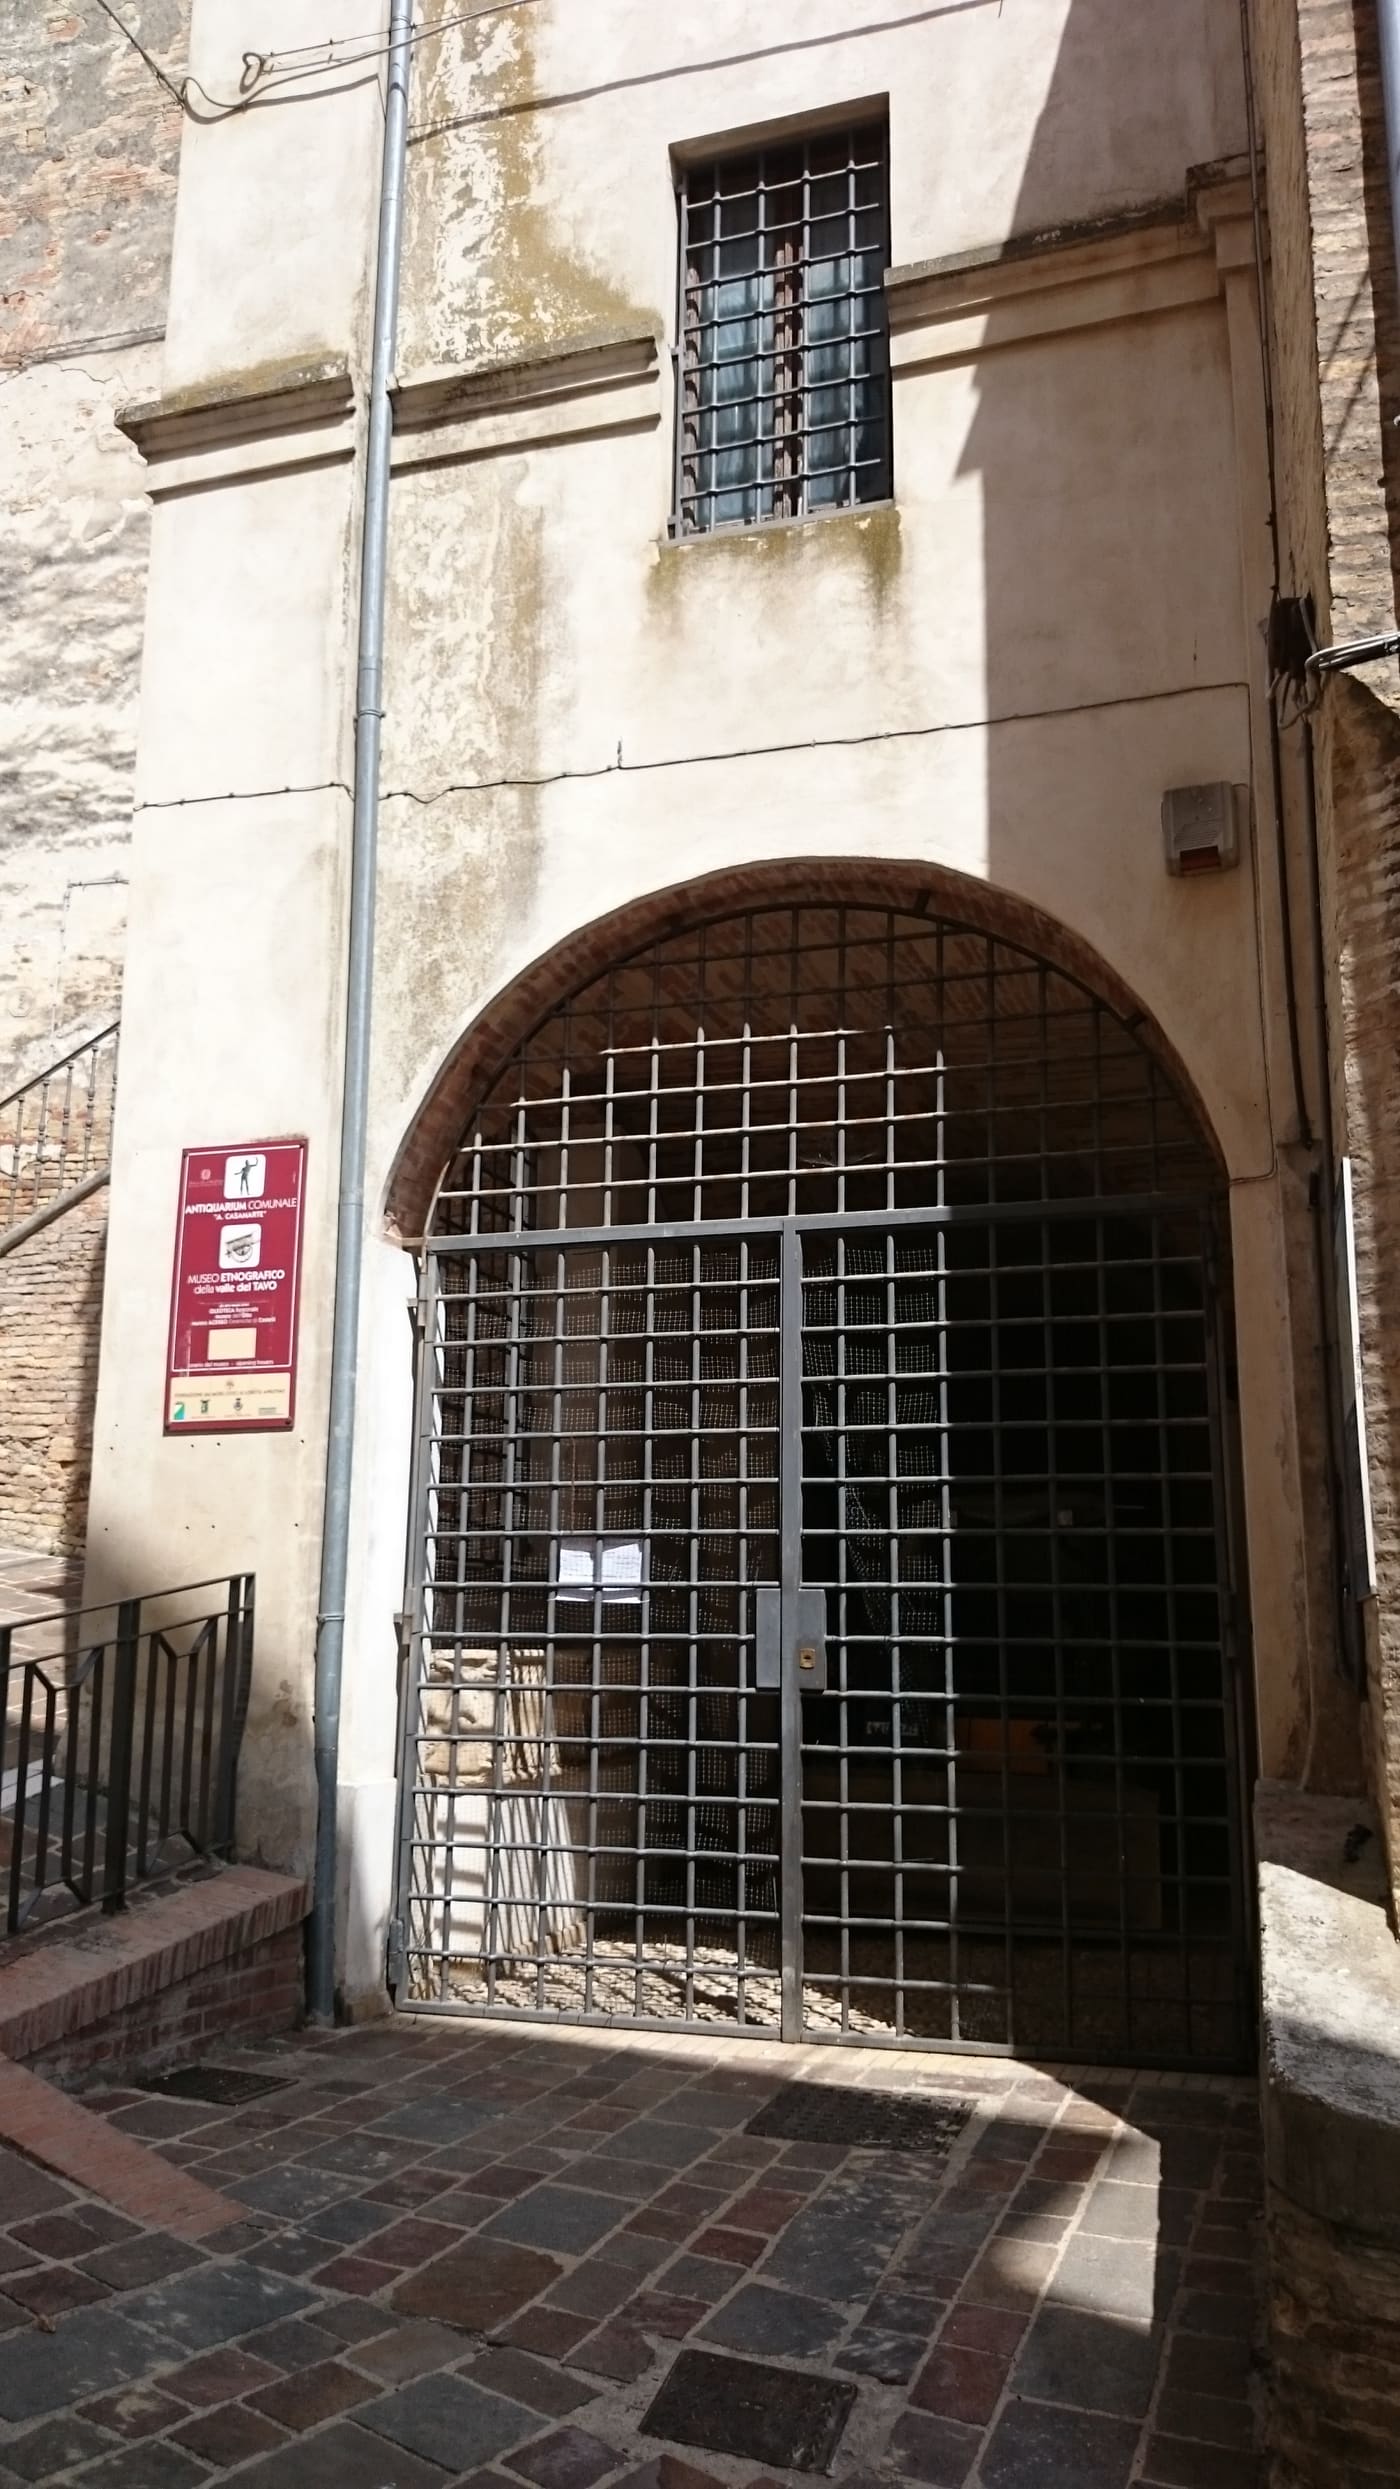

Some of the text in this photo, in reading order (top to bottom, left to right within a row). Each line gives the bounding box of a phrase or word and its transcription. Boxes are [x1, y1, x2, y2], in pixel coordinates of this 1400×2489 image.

[185, 1198, 297, 1214] ANTIQUARIUM COMUNALE
[188, 1270, 285, 1284] MUSEO ETNOGRAFICO
[194, 1281, 278, 1294] della valle del TAVO
